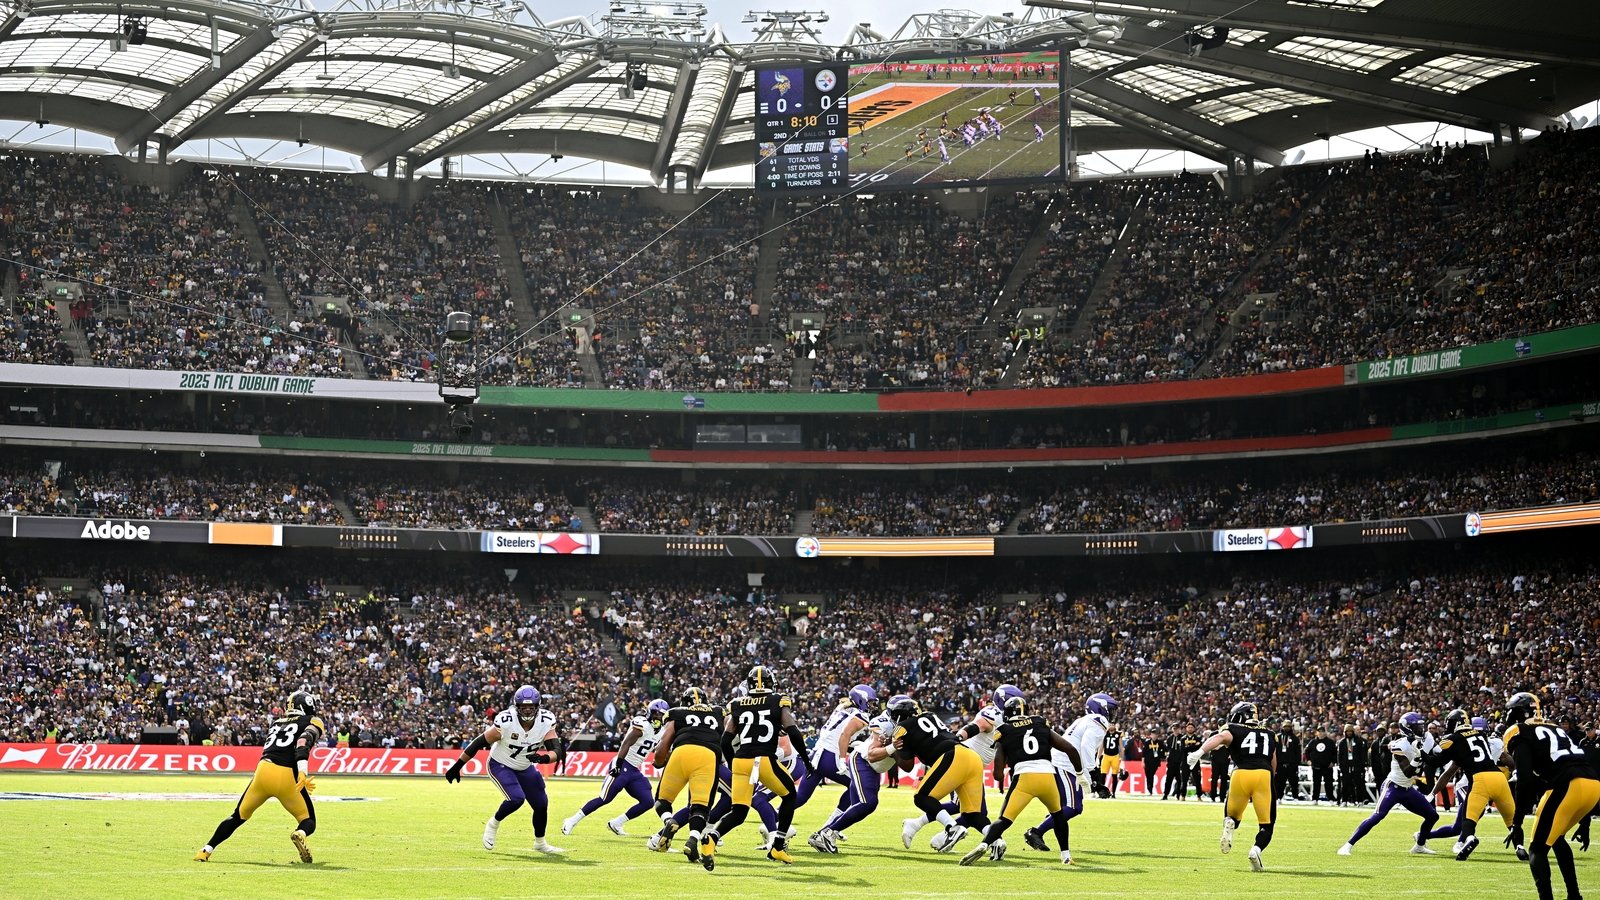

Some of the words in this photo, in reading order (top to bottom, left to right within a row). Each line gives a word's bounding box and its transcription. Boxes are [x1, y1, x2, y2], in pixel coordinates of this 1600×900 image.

[777, 98, 787, 112] 0
[821, 96, 831, 109] 0
[791, 116, 817, 127] 8:10
[783, 143, 803, 154] GAME
[804, 142, 824, 152] STATS
[1368, 362, 1390, 379] 2025
[1392, 357, 1409, 376] NFL
[1411, 352, 1438, 374] DUBLIN
[1440, 349, 1462, 369] GAME
[180, 374, 210, 388] 2025
[214, 374, 233, 389] NFL
[238, 375, 280, 391] DUBLIN
[282, 378, 316, 394] GAME
[412, 444, 430, 453] 2025
[432, 444, 444, 454] NFL
[447, 445, 472, 455] DUBLIN
[472, 446, 494, 456] GAME
[80, 520, 150, 540] Adobe
[1228, 533, 1263, 545] Steelers
[496, 536, 535, 548] Steelers
[740, 696, 767, 706] ELLIOTT
[738, 709, 774, 745] 25
[917, 714, 950, 739] 94
[1012, 718, 1033, 728] QUEEN
[1022, 728, 1039, 755] 6
[1106, 738, 1116, 749] 15
[1240, 731, 1269, 756] 41
[1466, 735, 1494, 762] 51
[1534, 726, 1585, 762] 22
[56, 743, 140, 770] Bud
[139, 754, 236, 771] ZERO
[312, 747, 392, 774] Bud
[391, 757, 483, 774] ZERO
[560, 751, 610, 777] Bu
